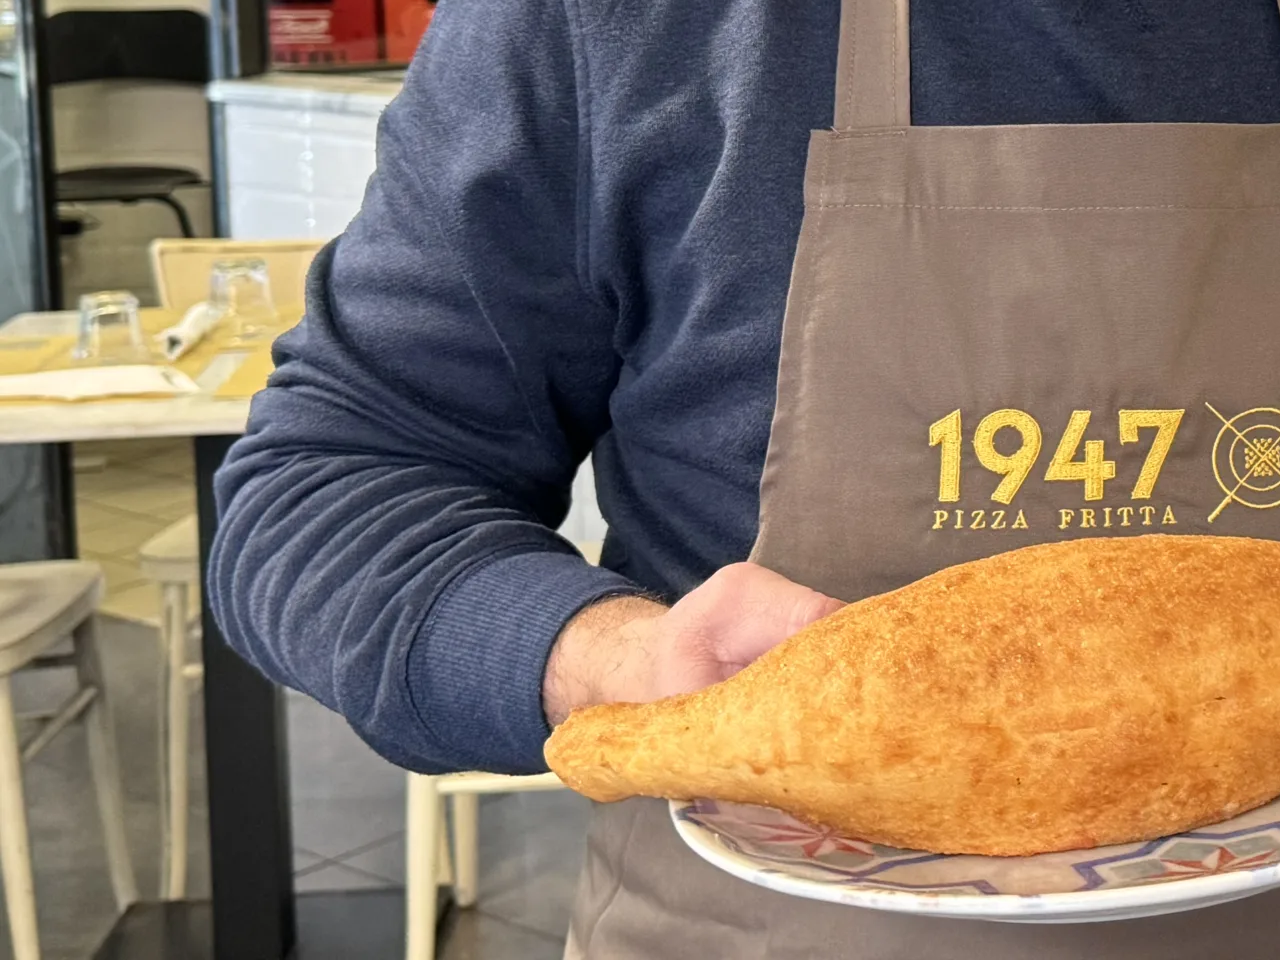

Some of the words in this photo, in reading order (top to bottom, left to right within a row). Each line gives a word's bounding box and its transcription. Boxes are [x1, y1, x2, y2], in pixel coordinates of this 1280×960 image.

[929, 407, 1185, 505] 1947
[931, 509, 1030, 530] PIZZA
[1058, 505, 1179, 530] FRITTA
